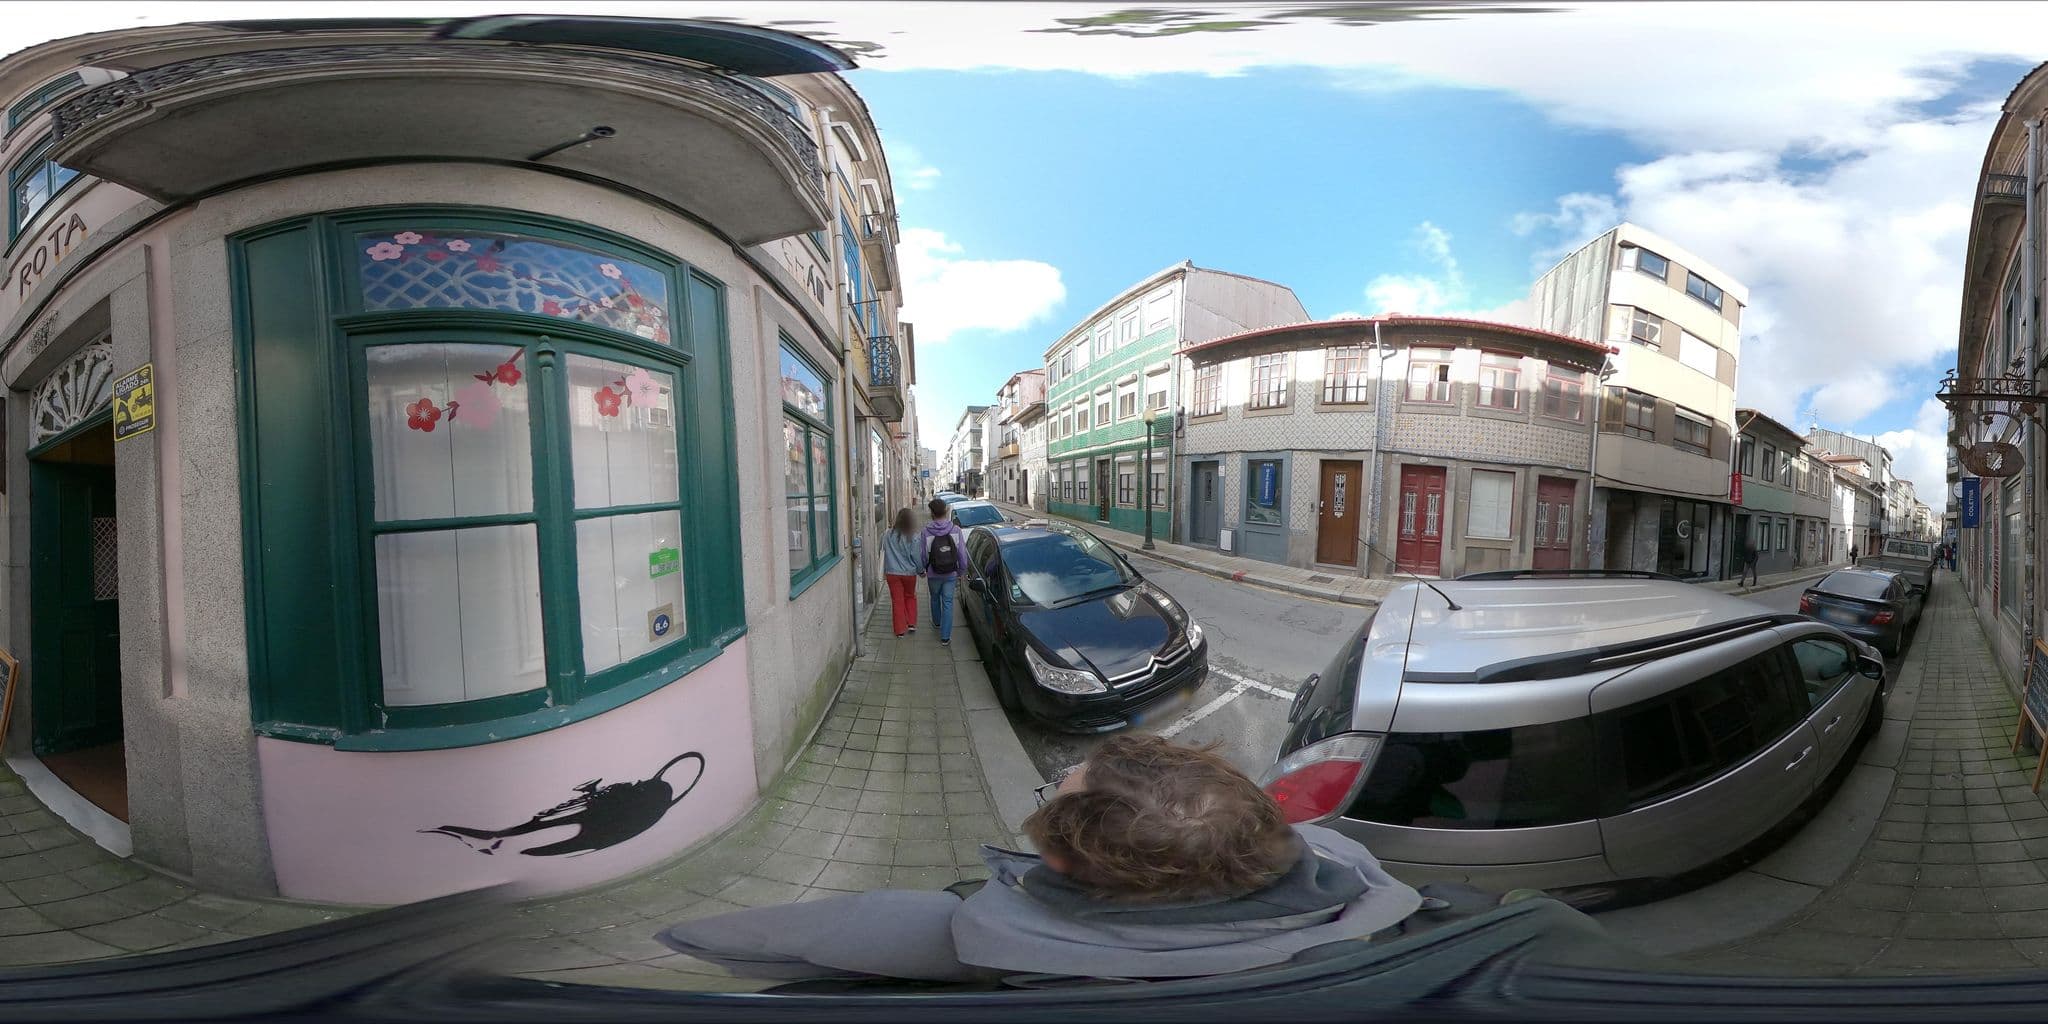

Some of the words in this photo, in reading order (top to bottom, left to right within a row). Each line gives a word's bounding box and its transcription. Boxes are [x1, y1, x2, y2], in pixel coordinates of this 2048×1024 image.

[19, 213, 87, 297] ROTA
[116, 374, 138, 388] ALARME
[116, 380, 139, 397] LIGADO
